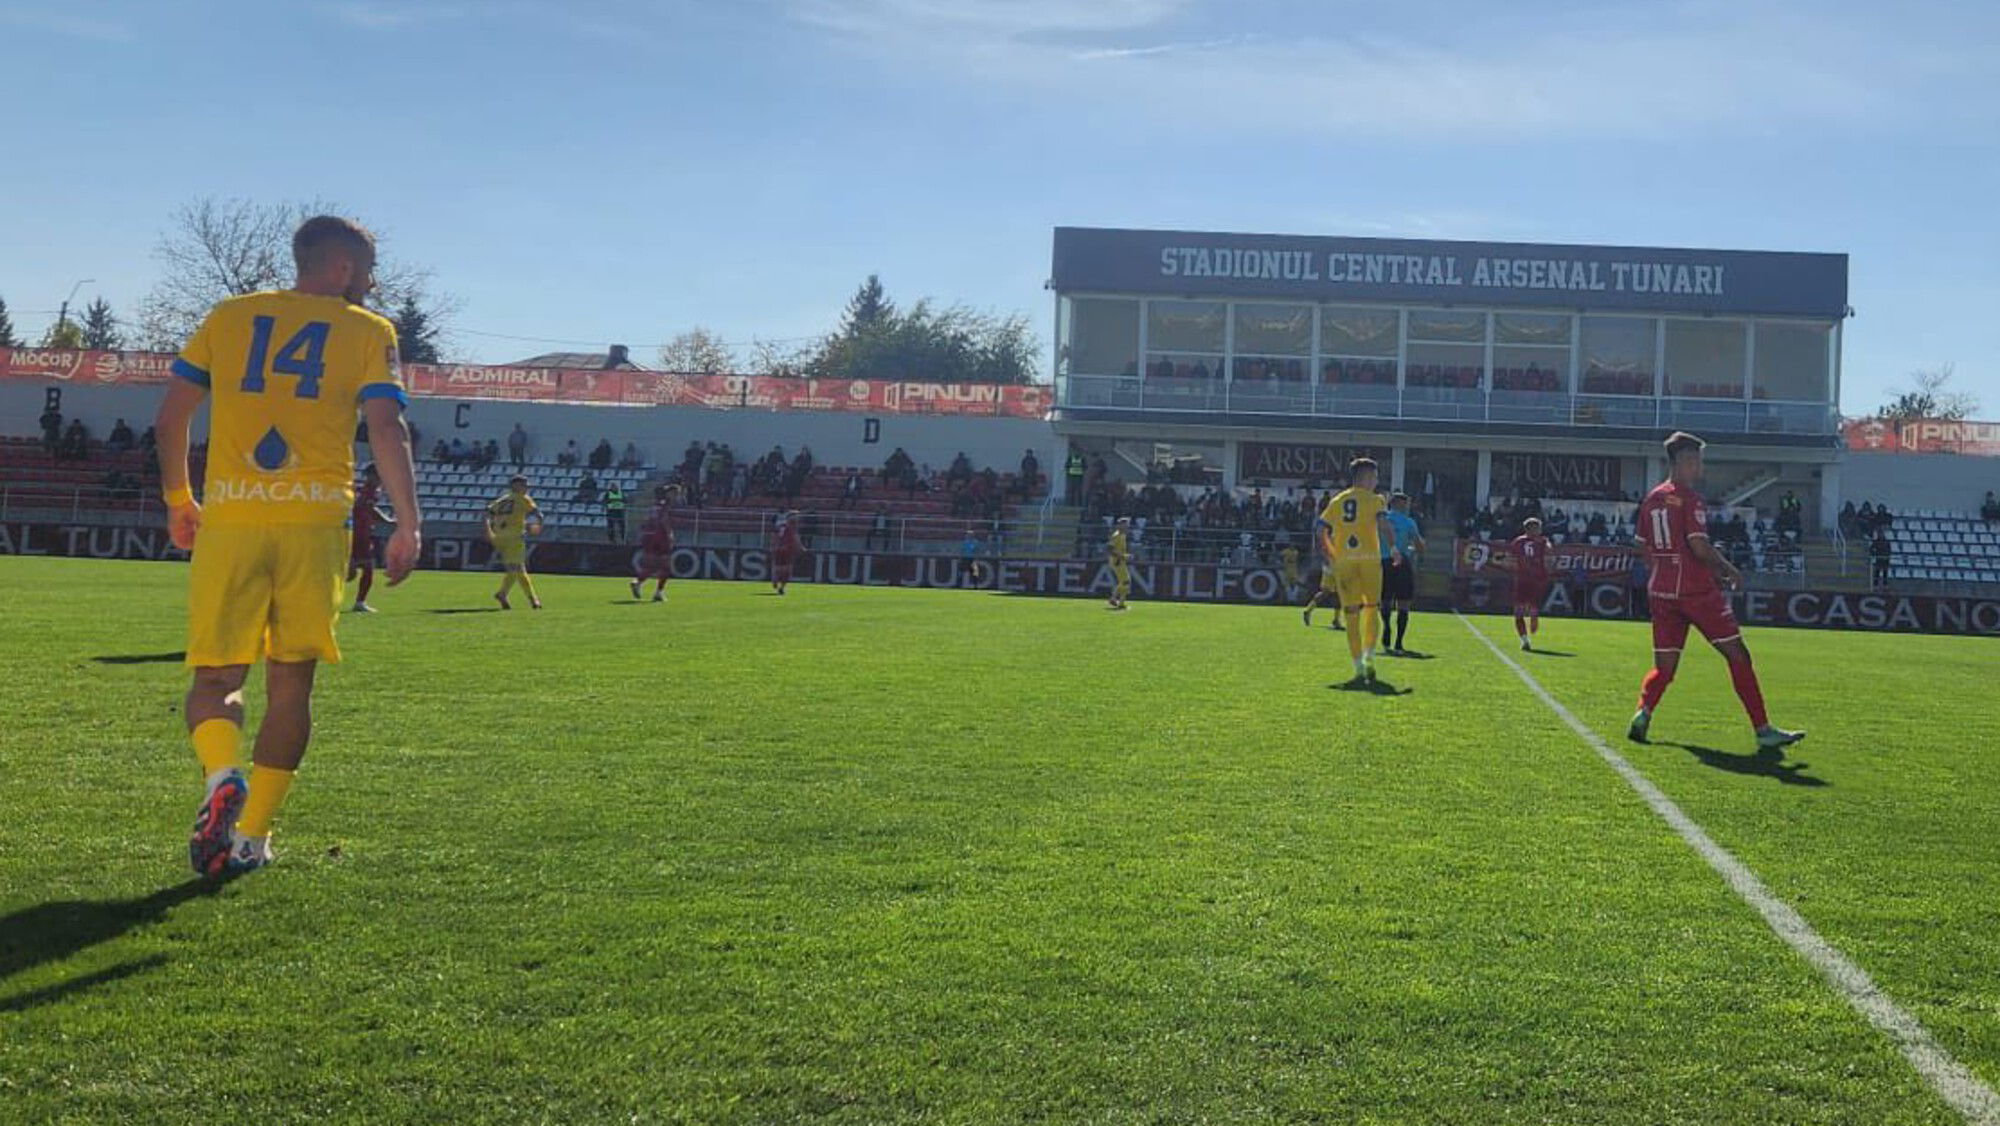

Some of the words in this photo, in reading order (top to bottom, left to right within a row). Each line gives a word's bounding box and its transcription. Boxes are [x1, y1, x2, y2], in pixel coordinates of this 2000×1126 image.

[1160, 247, 1319, 280] STADIONUL
[1328, 253, 1462, 285] CENTRAL
[1472, 257, 1605, 291] ARSENAL
[1611, 262, 1724, 295] TUNARI
[239, 314, 332, 399] 14
[449, 366, 556, 386] ADMIRAL
[46, 387, 62, 411] B
[904, 382, 1003, 403] PINUM
[455, 403, 472, 429] C
[863, 418, 881, 444] D
[1922, 423, 2000, 442] PINU
[1506, 455, 1609, 486] TUNARI
[1342, 500, 1358, 522] 9
[1651, 508, 1673, 549] 11
[1787, 592, 1921, 628] CASA
[1935, 600, 2000, 632] NO
